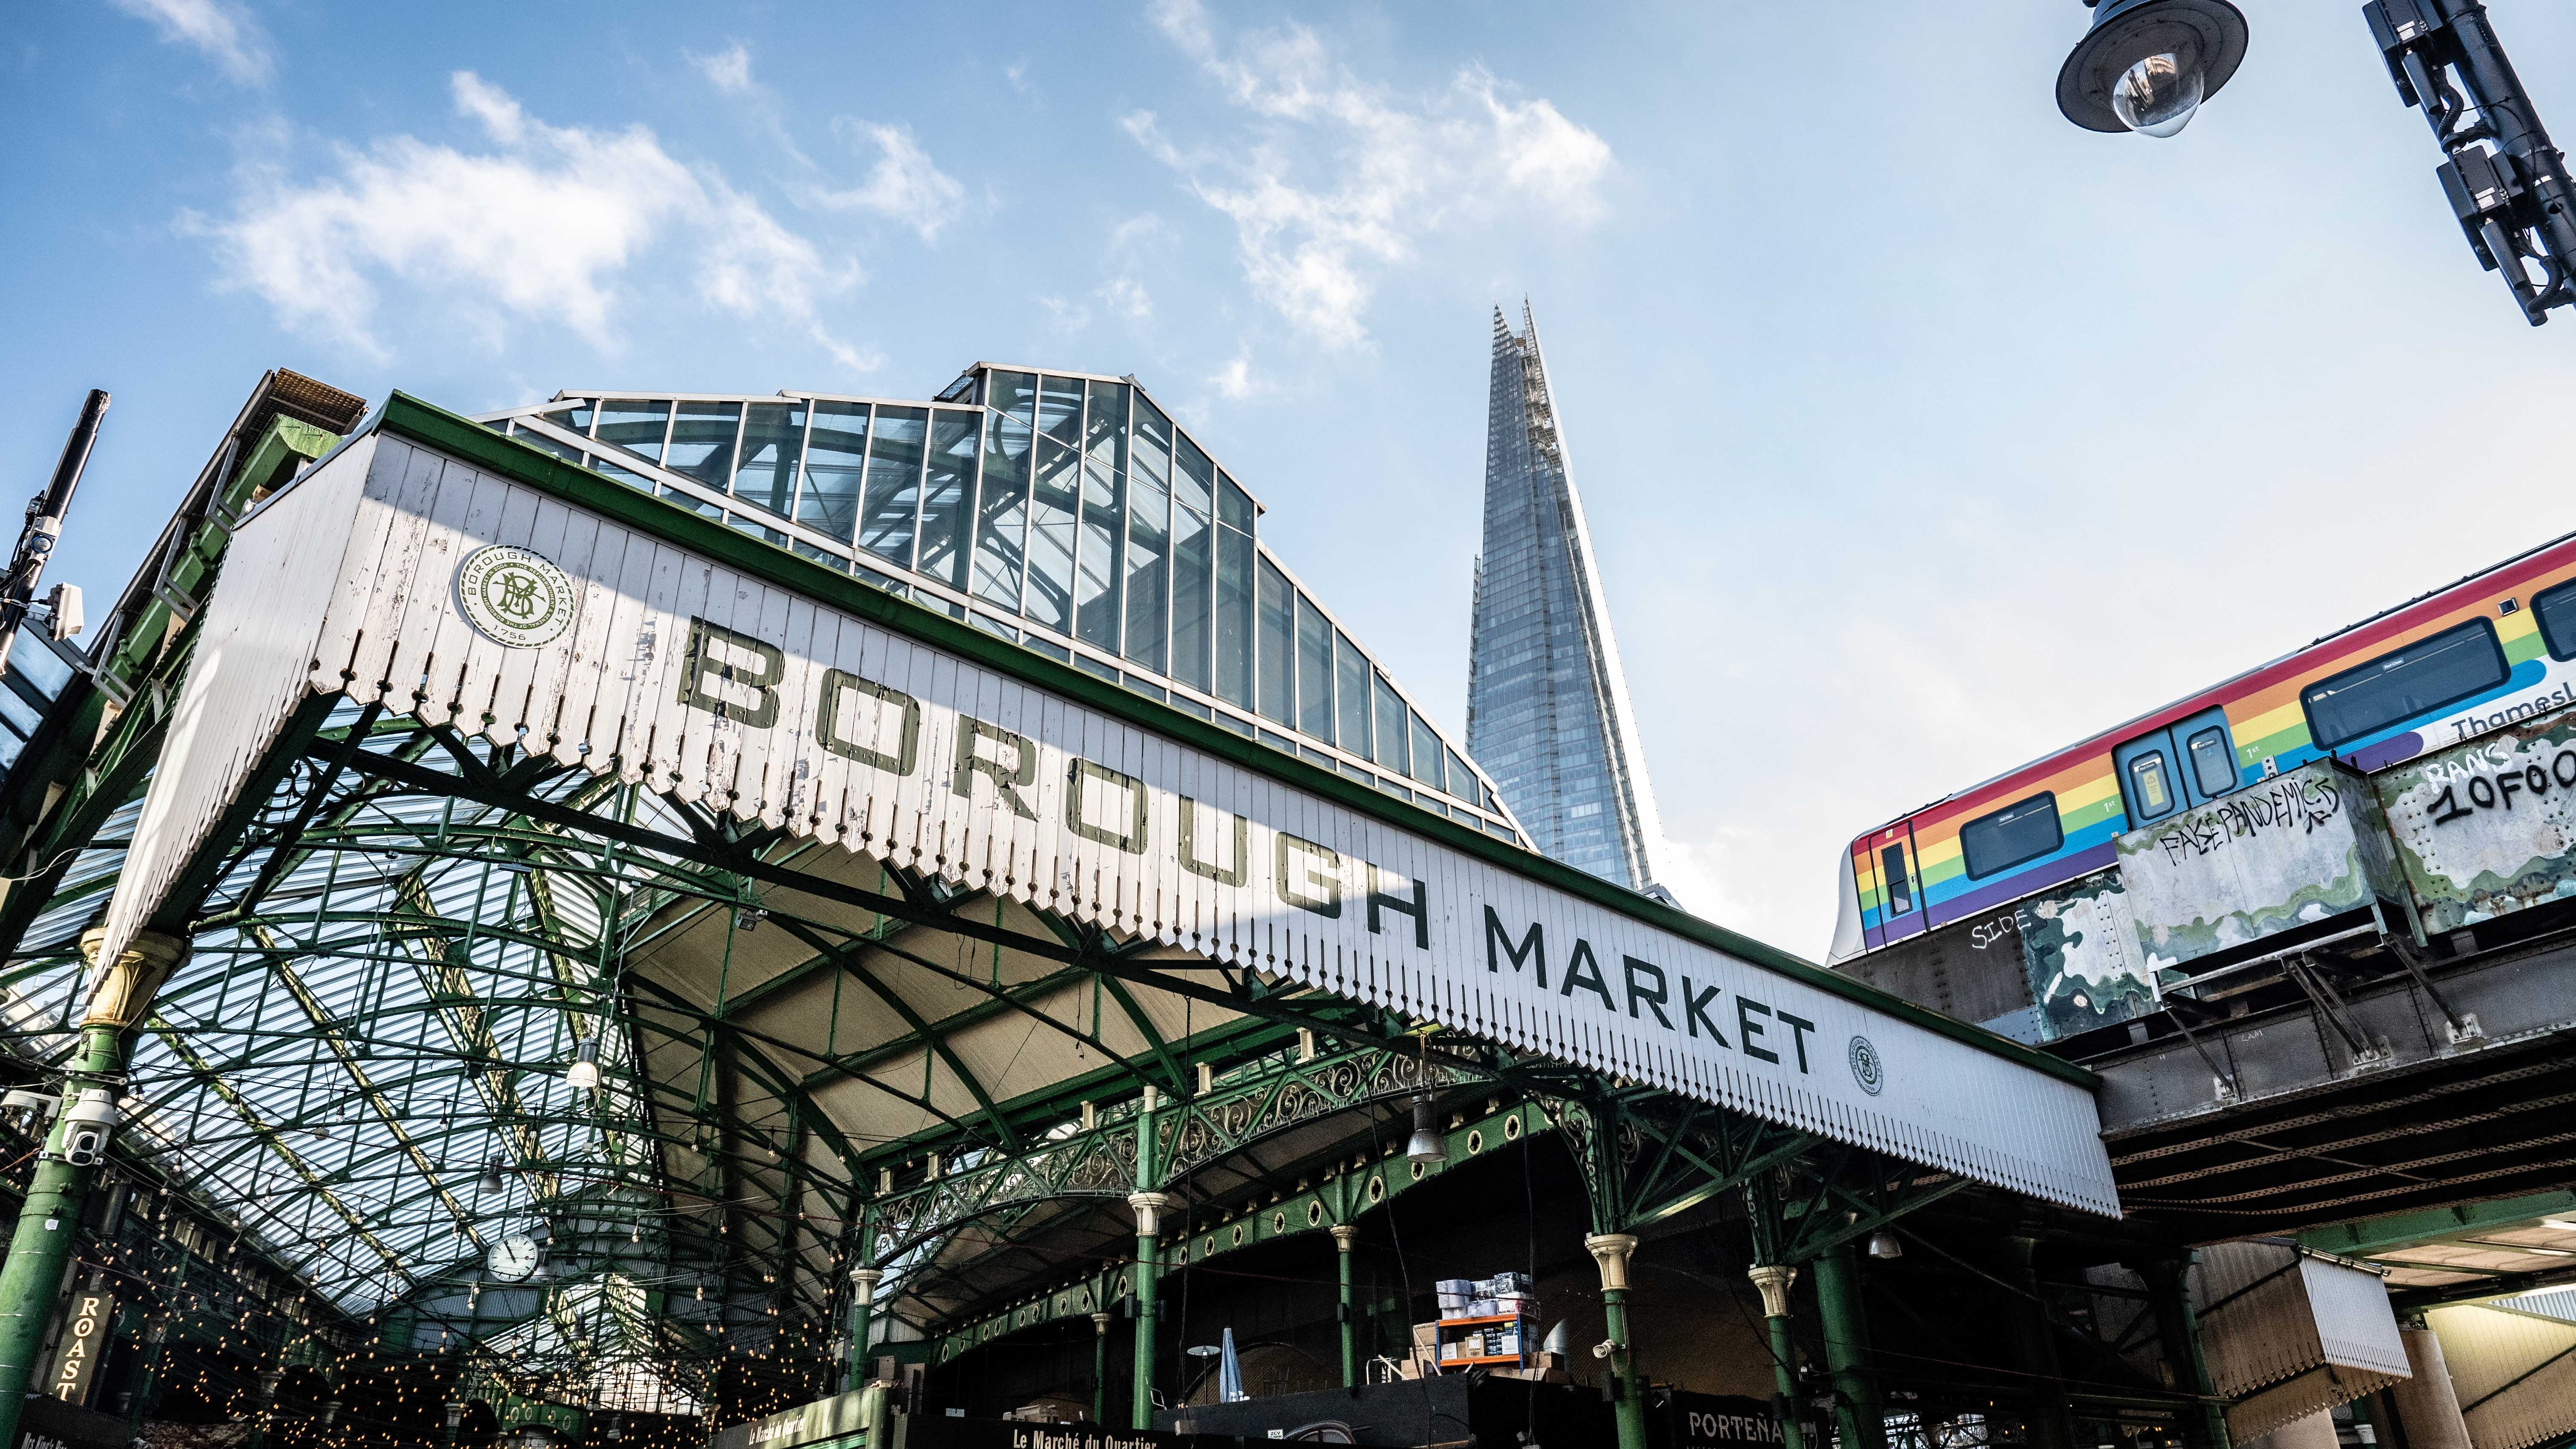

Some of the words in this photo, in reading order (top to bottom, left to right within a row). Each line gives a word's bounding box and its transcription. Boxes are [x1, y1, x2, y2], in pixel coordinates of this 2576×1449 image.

[493, 563, 508, 571] 2004
[469, 552, 531, 596] BOROUGH
[539, 563, 567, 626] MARKET
[529, 568, 555, 608] REFURBISHMENT
[483, 597, 505, 622] BOROUGH
[528, 613, 551, 628] RENEWAL
[494, 625, 526, 640] 1756
[2246, 746, 2260, 758] 1st
[2104, 801, 2116, 812] 1st
[677, 614, 1429, 950] BOROUGH
[1484, 904, 1815, 1075] MARKET
[1972, 909, 2032, 950] SIDE
[56, 1297, 100, 1402] ROAST
[749, 1428, 756, 1446] Le
[1689, 1412, 1785, 1443] PORTEÑA
[1013, 1429, 1027, 1449] Le
[1033, 1430, 1080, 1449] Marché
[1085, 1434, 1100, 1449] du
